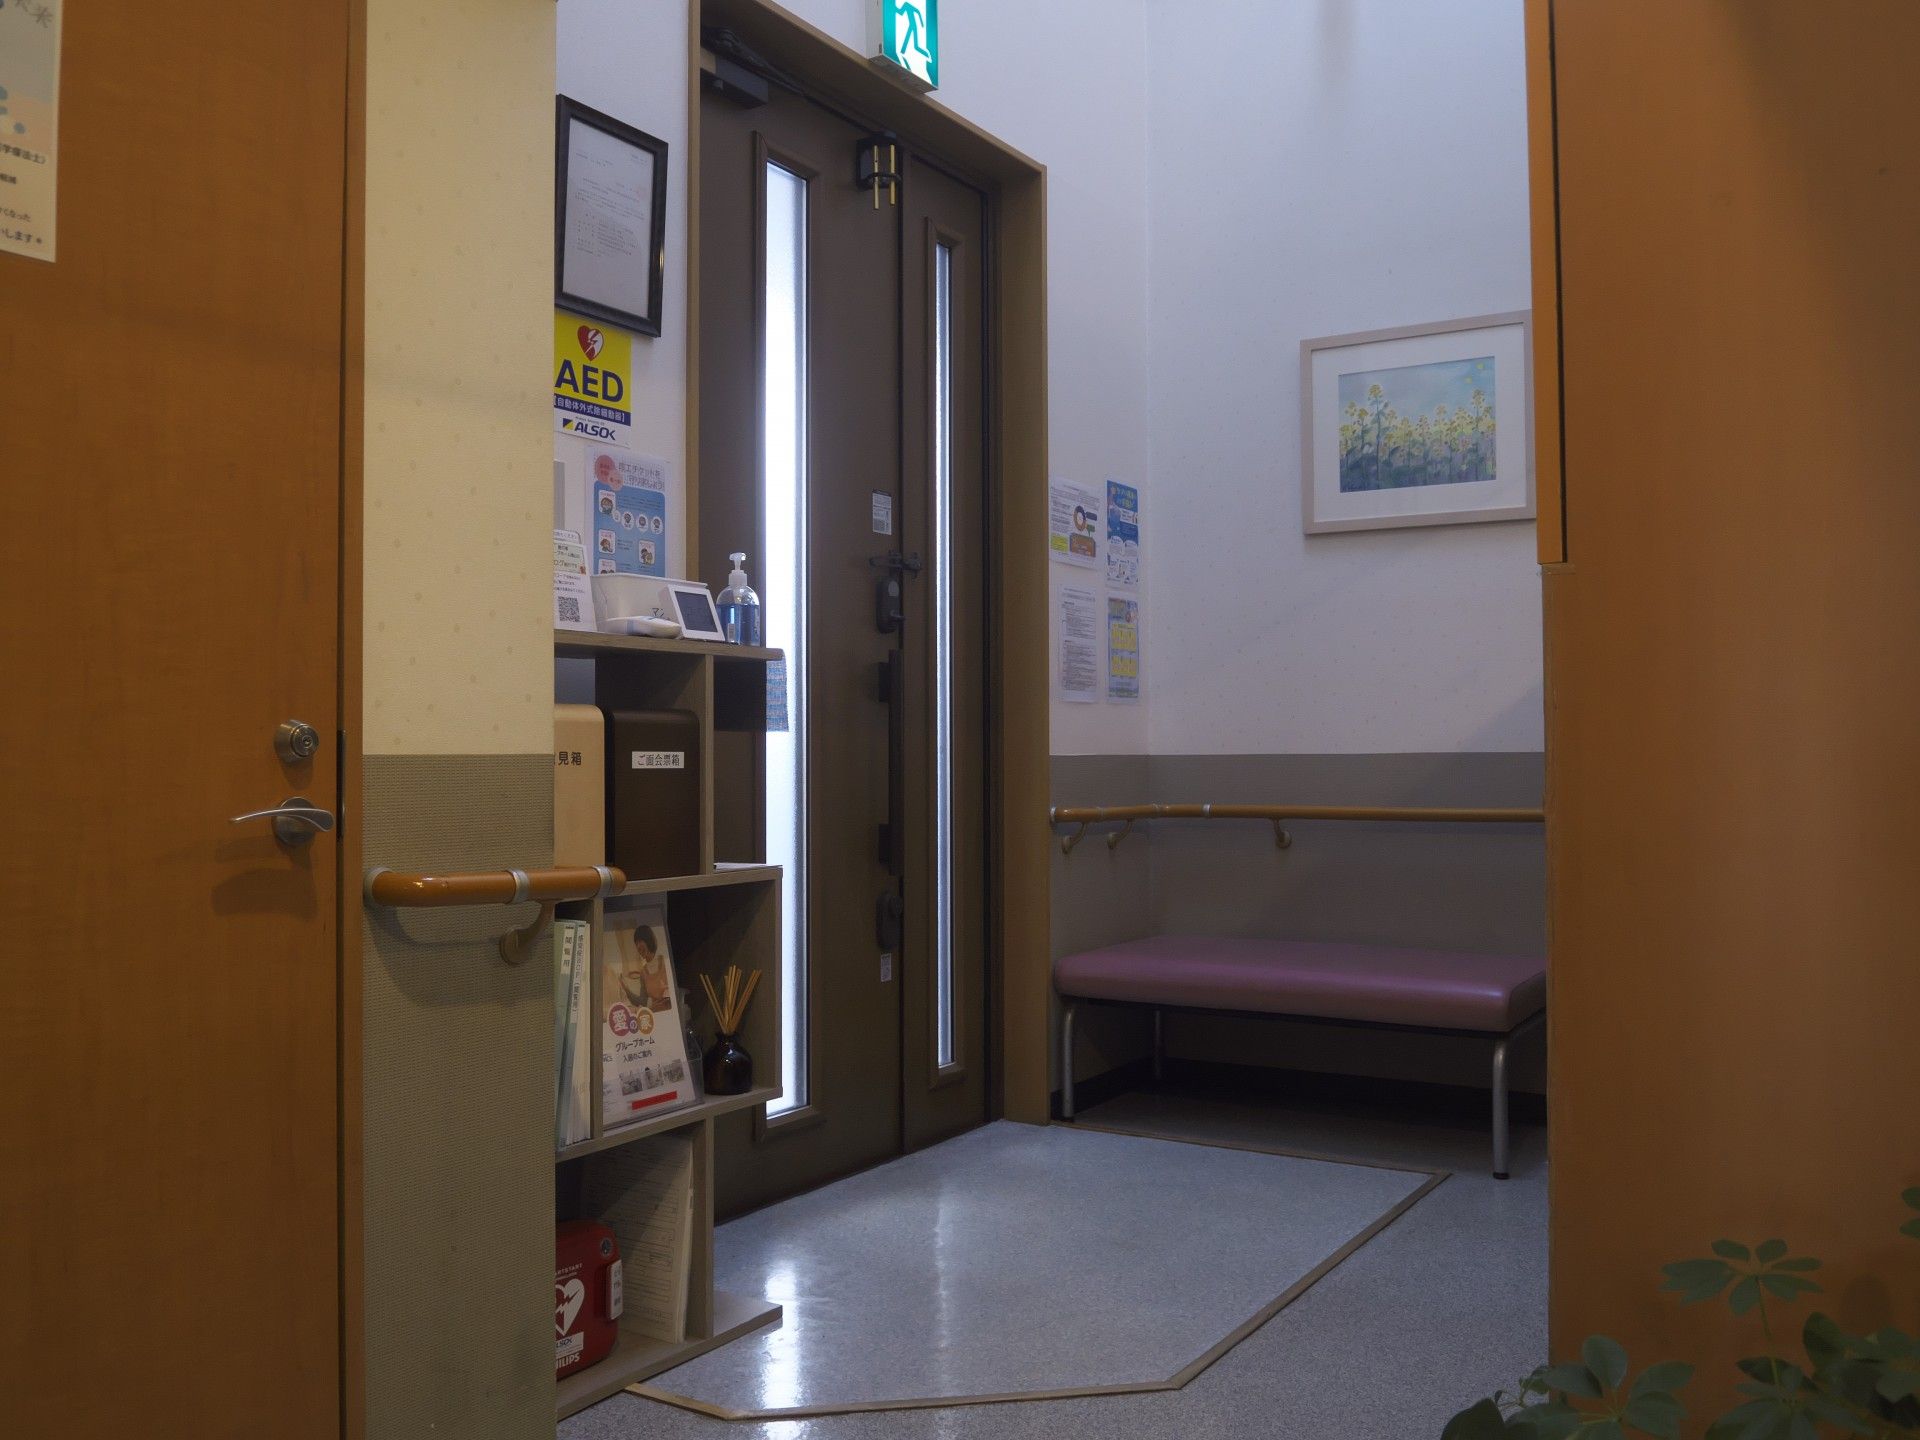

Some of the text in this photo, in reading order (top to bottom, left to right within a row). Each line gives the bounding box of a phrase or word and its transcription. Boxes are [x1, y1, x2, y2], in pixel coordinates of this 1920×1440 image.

[554, 359, 624, 403] AED
[574, 421, 616, 441] ALSOK
[554, 751, 582, 766] 見箱
[616, 1036, 655, 1052] グループホーム
